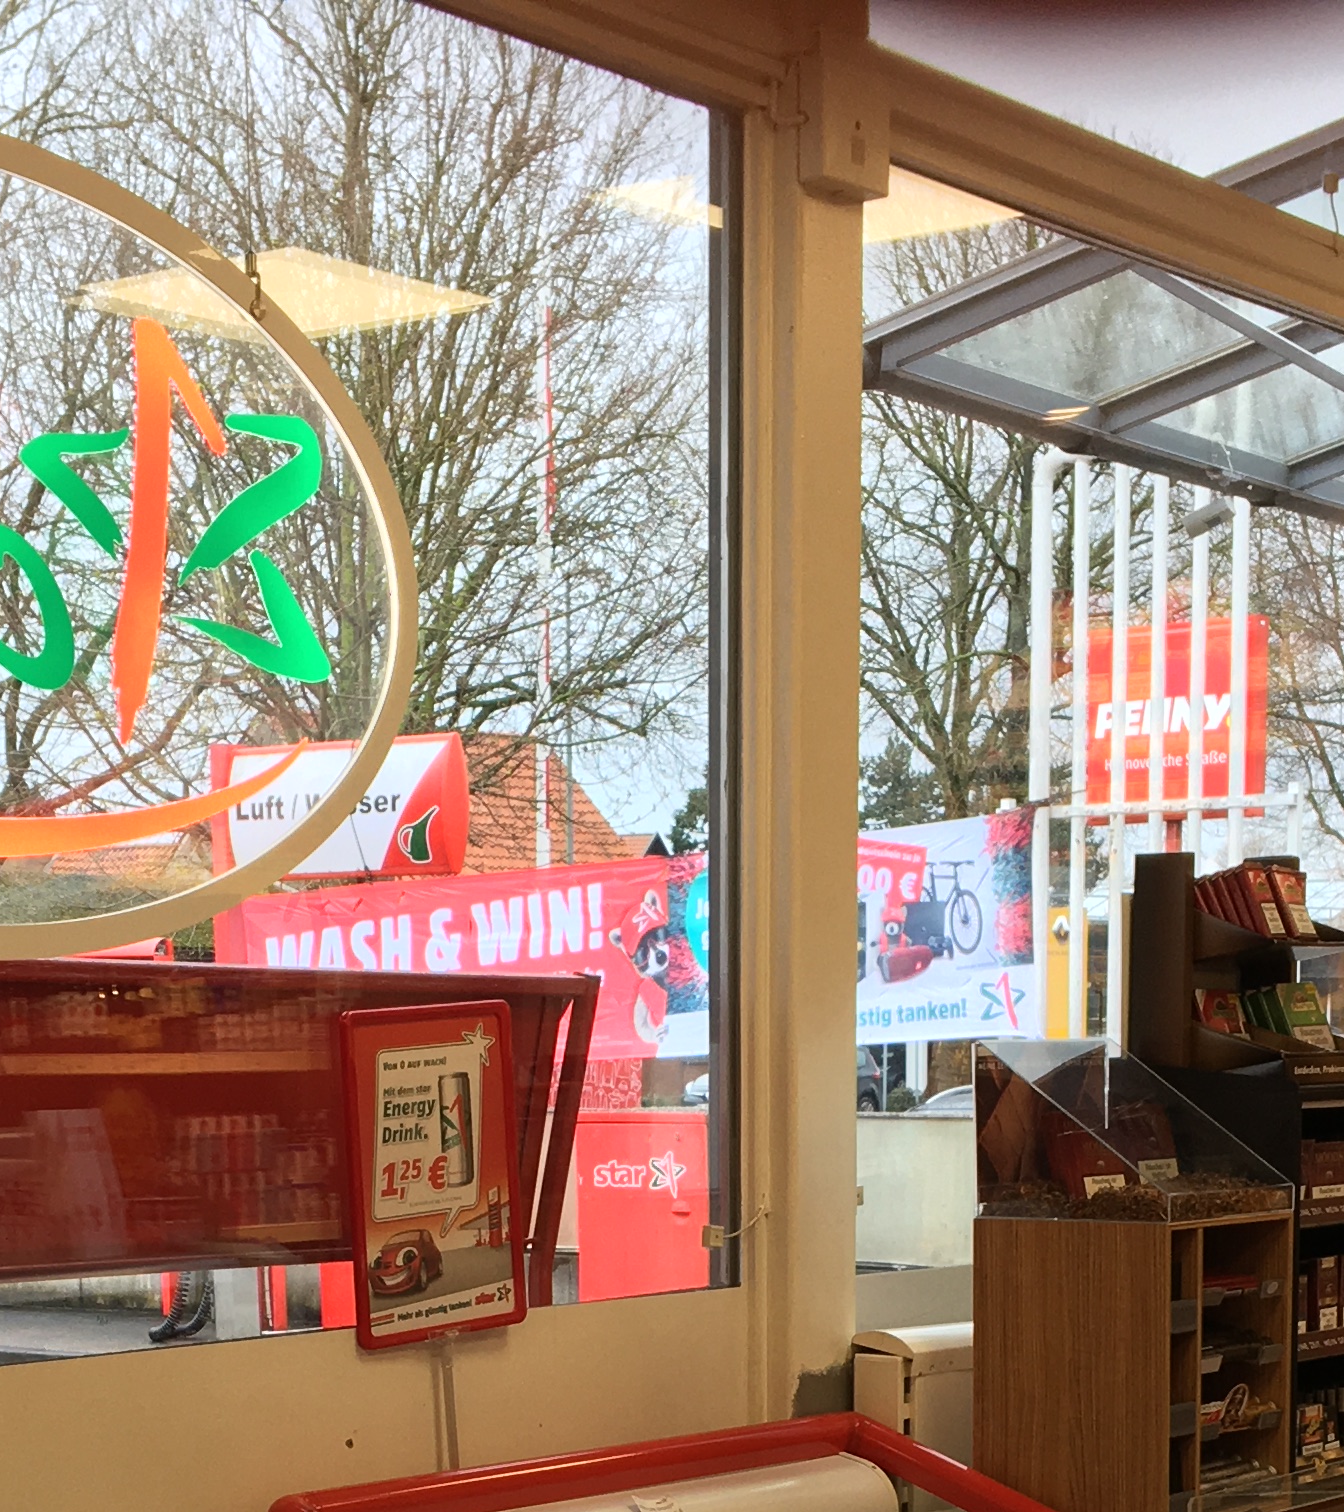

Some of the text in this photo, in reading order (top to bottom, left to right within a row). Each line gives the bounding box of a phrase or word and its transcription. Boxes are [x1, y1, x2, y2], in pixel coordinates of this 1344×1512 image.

[1104, 752, 1184, 771] Hnoveche
[235, 796, 285, 821] Luft
[304, 789, 401, 816] Wser
[266, 881, 604, 973] WASH & WIN!
[896, 997, 968, 1024] tanken!
[383, 1086, 396, 1098] Mit
[383, 1099, 436, 1118] Energy
[382, 1122, 429, 1144] Drink.
[380, 1154, 449, 1201] 1,25 €
[593, 1160, 646, 1188] star
